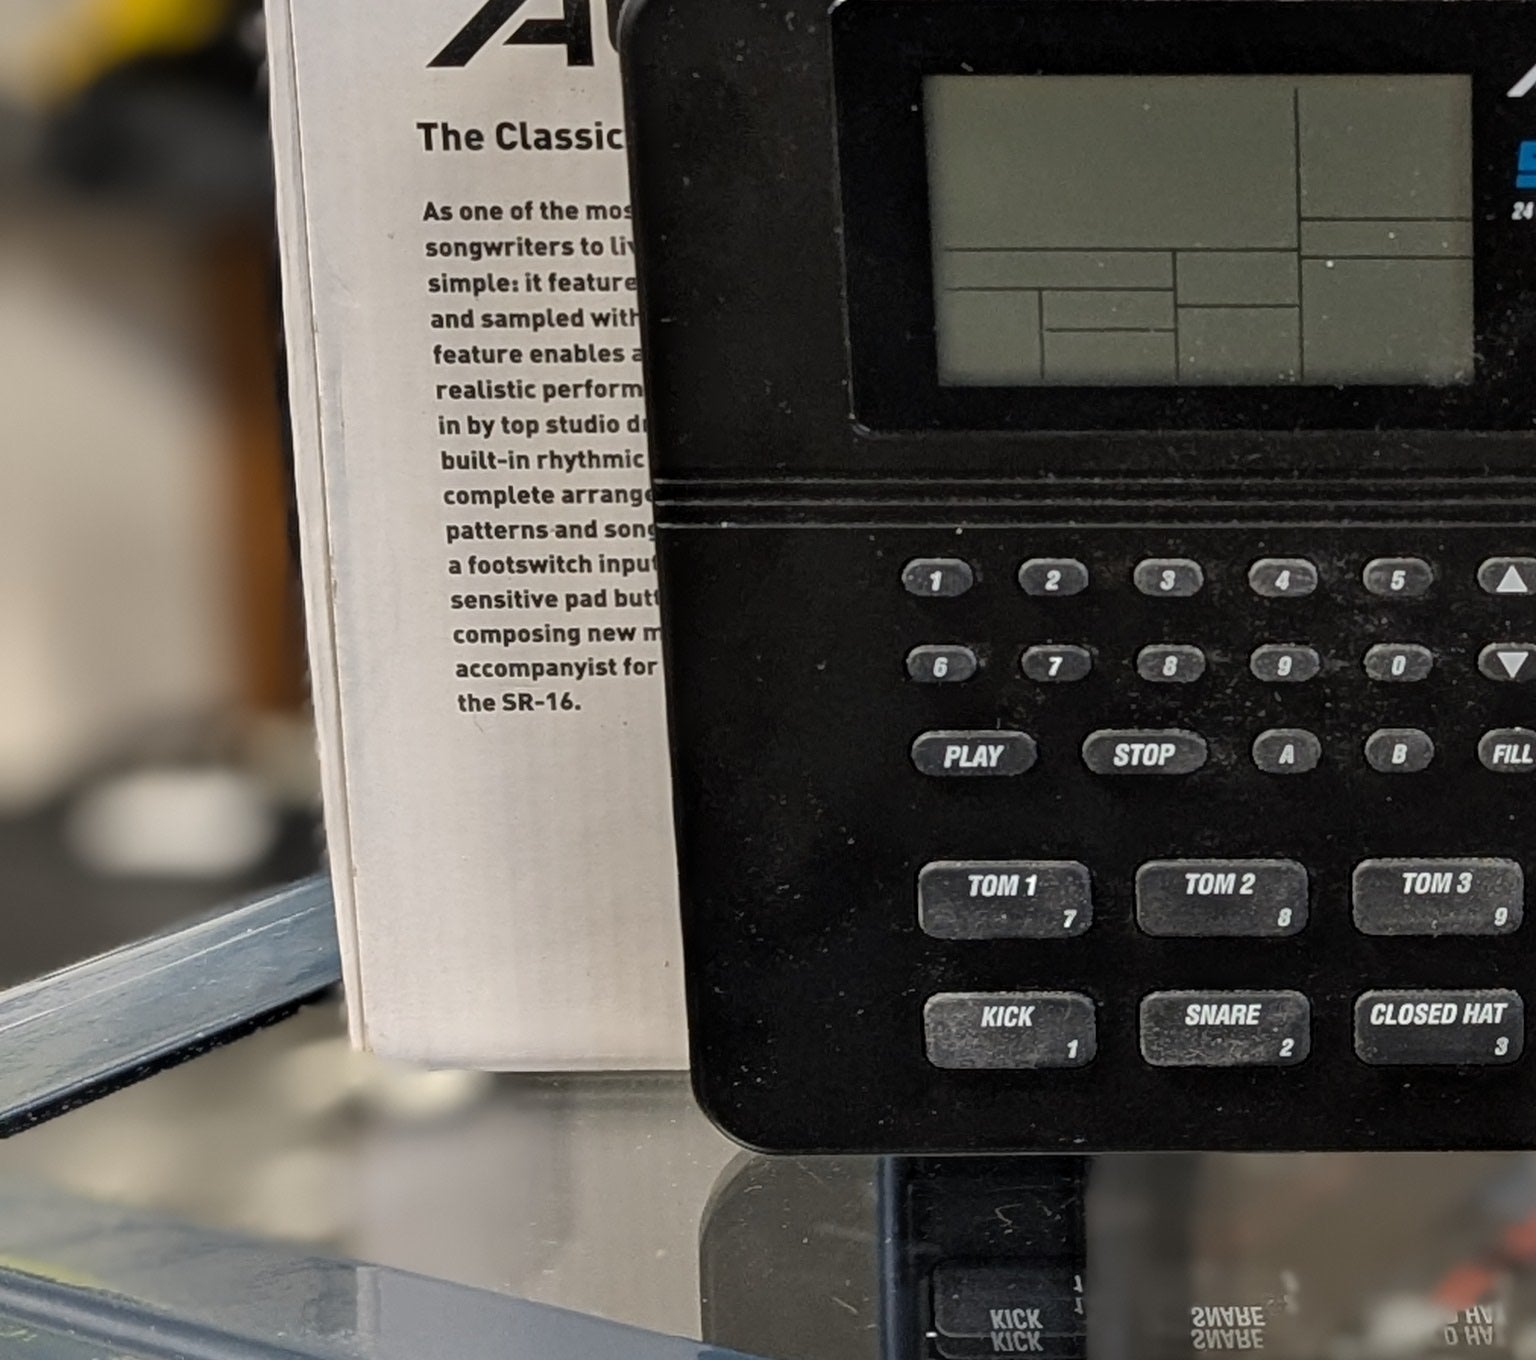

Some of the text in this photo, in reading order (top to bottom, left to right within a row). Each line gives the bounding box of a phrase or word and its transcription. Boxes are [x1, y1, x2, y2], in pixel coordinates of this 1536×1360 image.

[417, 121, 624, 151] The Classic
[423, 202, 452, 221] As
[460, 205, 503, 221] one
[510, 202, 533, 220] of
[540, 201, 579, 220] the
[1512, 202, 1533, 220] 24
[426, 237, 573, 261] songwriters
[581, 237, 604, 256] to
[428, 273, 637, 296] simple: it feature
[431, 309, 474, 328] and
[481, 308, 584, 331] sampled
[433, 345, 523, 364] feature
[531, 344, 624, 362] enables
[437, 380, 643, 402] realistic perform
[439, 415, 620, 438] in by top studio
[442, 449, 644, 473] built-in rhythmic
[444, 486, 554, 508] complete
[446, 522, 548, 544] patterns
[555, 520, 597, 539] and
[449, 560, 461, 574] a
[468, 555, 592, 574] footswitch
[930, 570, 942, 591] 1
[1046, 570, 1059, 591] 2
[1161, 570, 1175, 591] 3
[1275, 570, 1289, 591] 4
[1391, 570, 1405, 590] 5
[451, 591, 558, 609] sensitive
[566, 589, 606, 611] pad
[453, 624, 580, 646] composing
[588, 627, 636, 641] new
[456, 657, 658, 680] accompanyist for
[934, 657, 947, 676] 6
[1049, 657, 1062, 676] 7
[1163, 657, 1176, 676] 8
[1278, 656, 1292, 676] 9
[458, 693, 581, 711] the SR-16.
[944, 746, 1003, 768] PLAY
[1114, 745, 1175, 766] STOP
[1279, 745, 1294, 764] A
[1392, 744, 1407, 764] B
[1492, 744, 1534, 764] FILL
[969, 875, 1038, 897] TOM 1
[1186, 874, 1256, 895] TOM 2
[1403, 873, 1472, 894] TOM 3
[1062, 910, 1077, 928] 7
[1277, 908, 1291, 927] 8
[1494, 908, 1508, 927] 9
[981, 1006, 1034, 1028] KICK
[1186, 1004, 1261, 1026] SNARE
[1371, 1003, 1508, 1025] CLOSED HAT
[1067, 1041, 1078, 1059] 1
[1280, 1039, 1293, 1058] 2
[1495, 1037, 1509, 1056] 3
